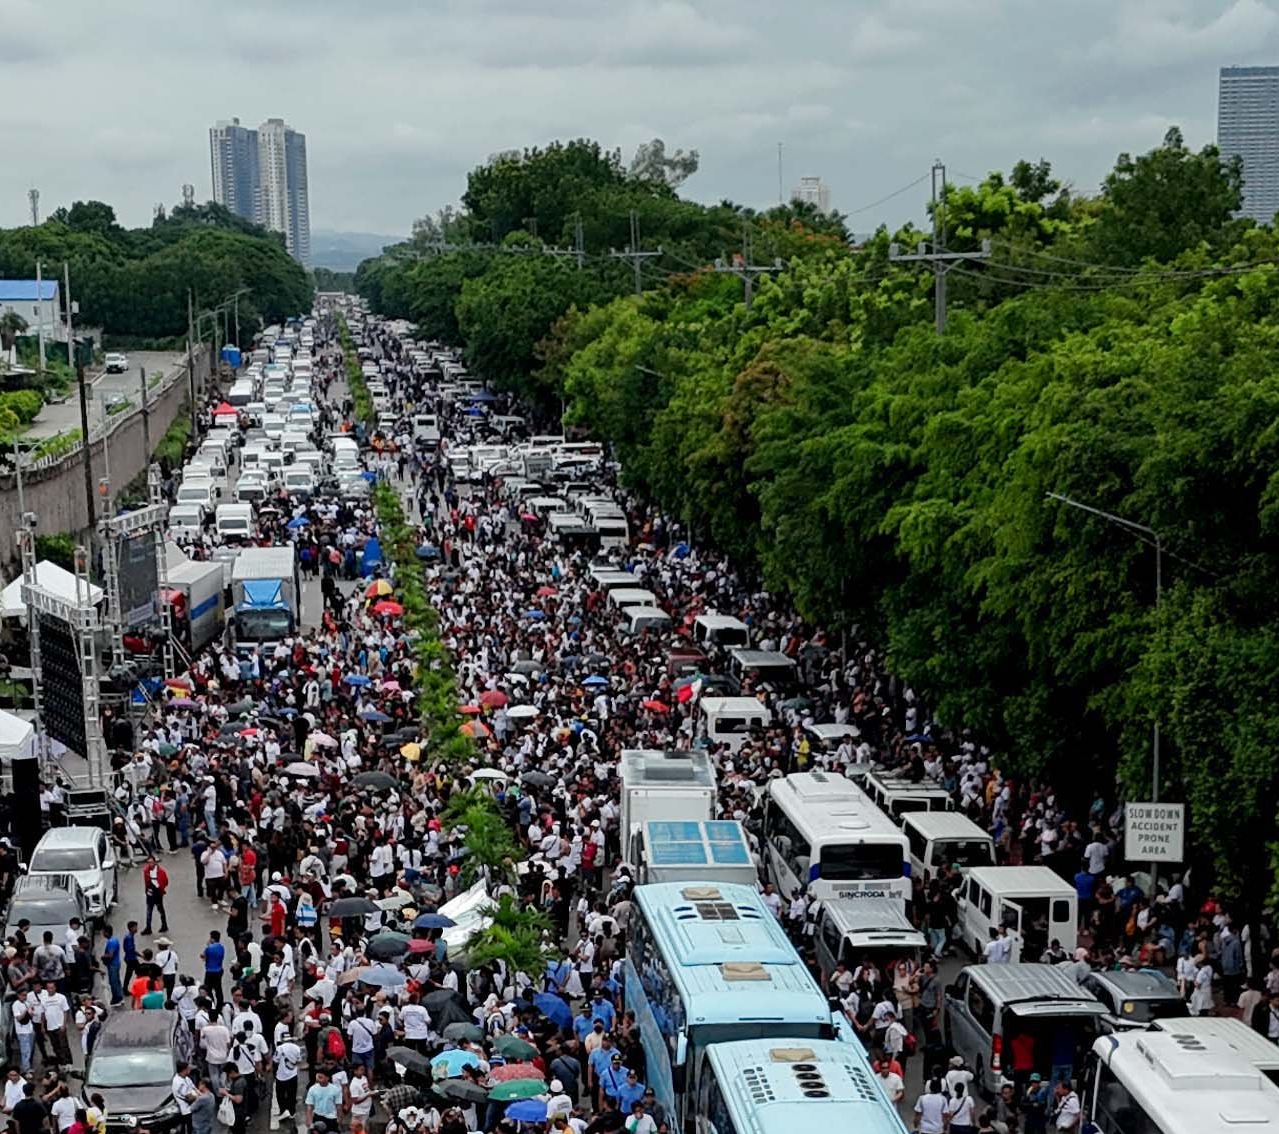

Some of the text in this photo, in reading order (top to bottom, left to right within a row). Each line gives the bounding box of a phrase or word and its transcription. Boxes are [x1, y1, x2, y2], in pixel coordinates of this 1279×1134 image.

[1129, 807, 1181, 820] SLOW DOWN
[1131, 822, 1178, 832] ACCIDENT
[1138, 834, 1170, 843] PRONE
[1141, 846, 1167, 855] AREA
[839, 890, 885, 899] SINCRODA
